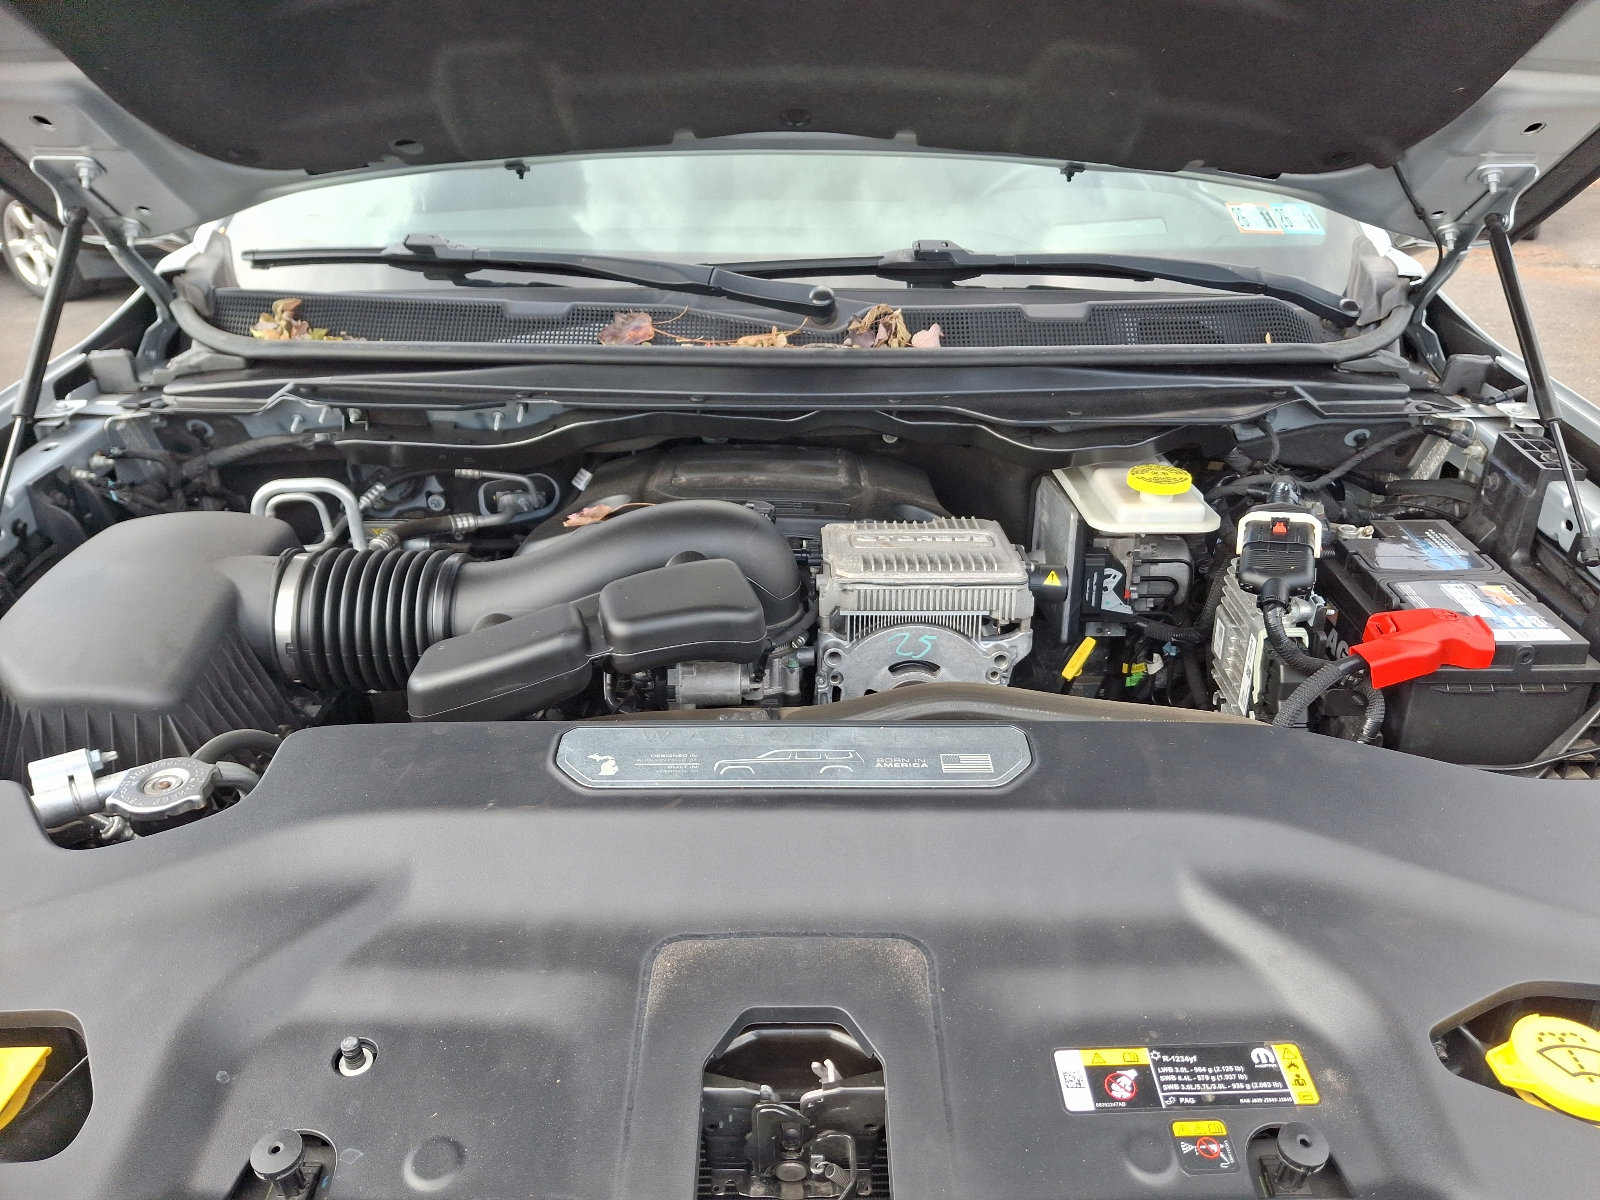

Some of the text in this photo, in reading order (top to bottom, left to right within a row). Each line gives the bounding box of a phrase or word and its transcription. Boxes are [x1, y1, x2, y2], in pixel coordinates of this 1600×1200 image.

[887, 632, 938, 659] 25
[1161, 1055, 1197, 1064] R-1234yf
[1213, 1065, 1234, 1073] (2.125
[1235, 1065, 1244, 1073] lb)
[1238, 1073, 1248, 1081] lb)
[1273, 1081, 1283, 1089] lb)
